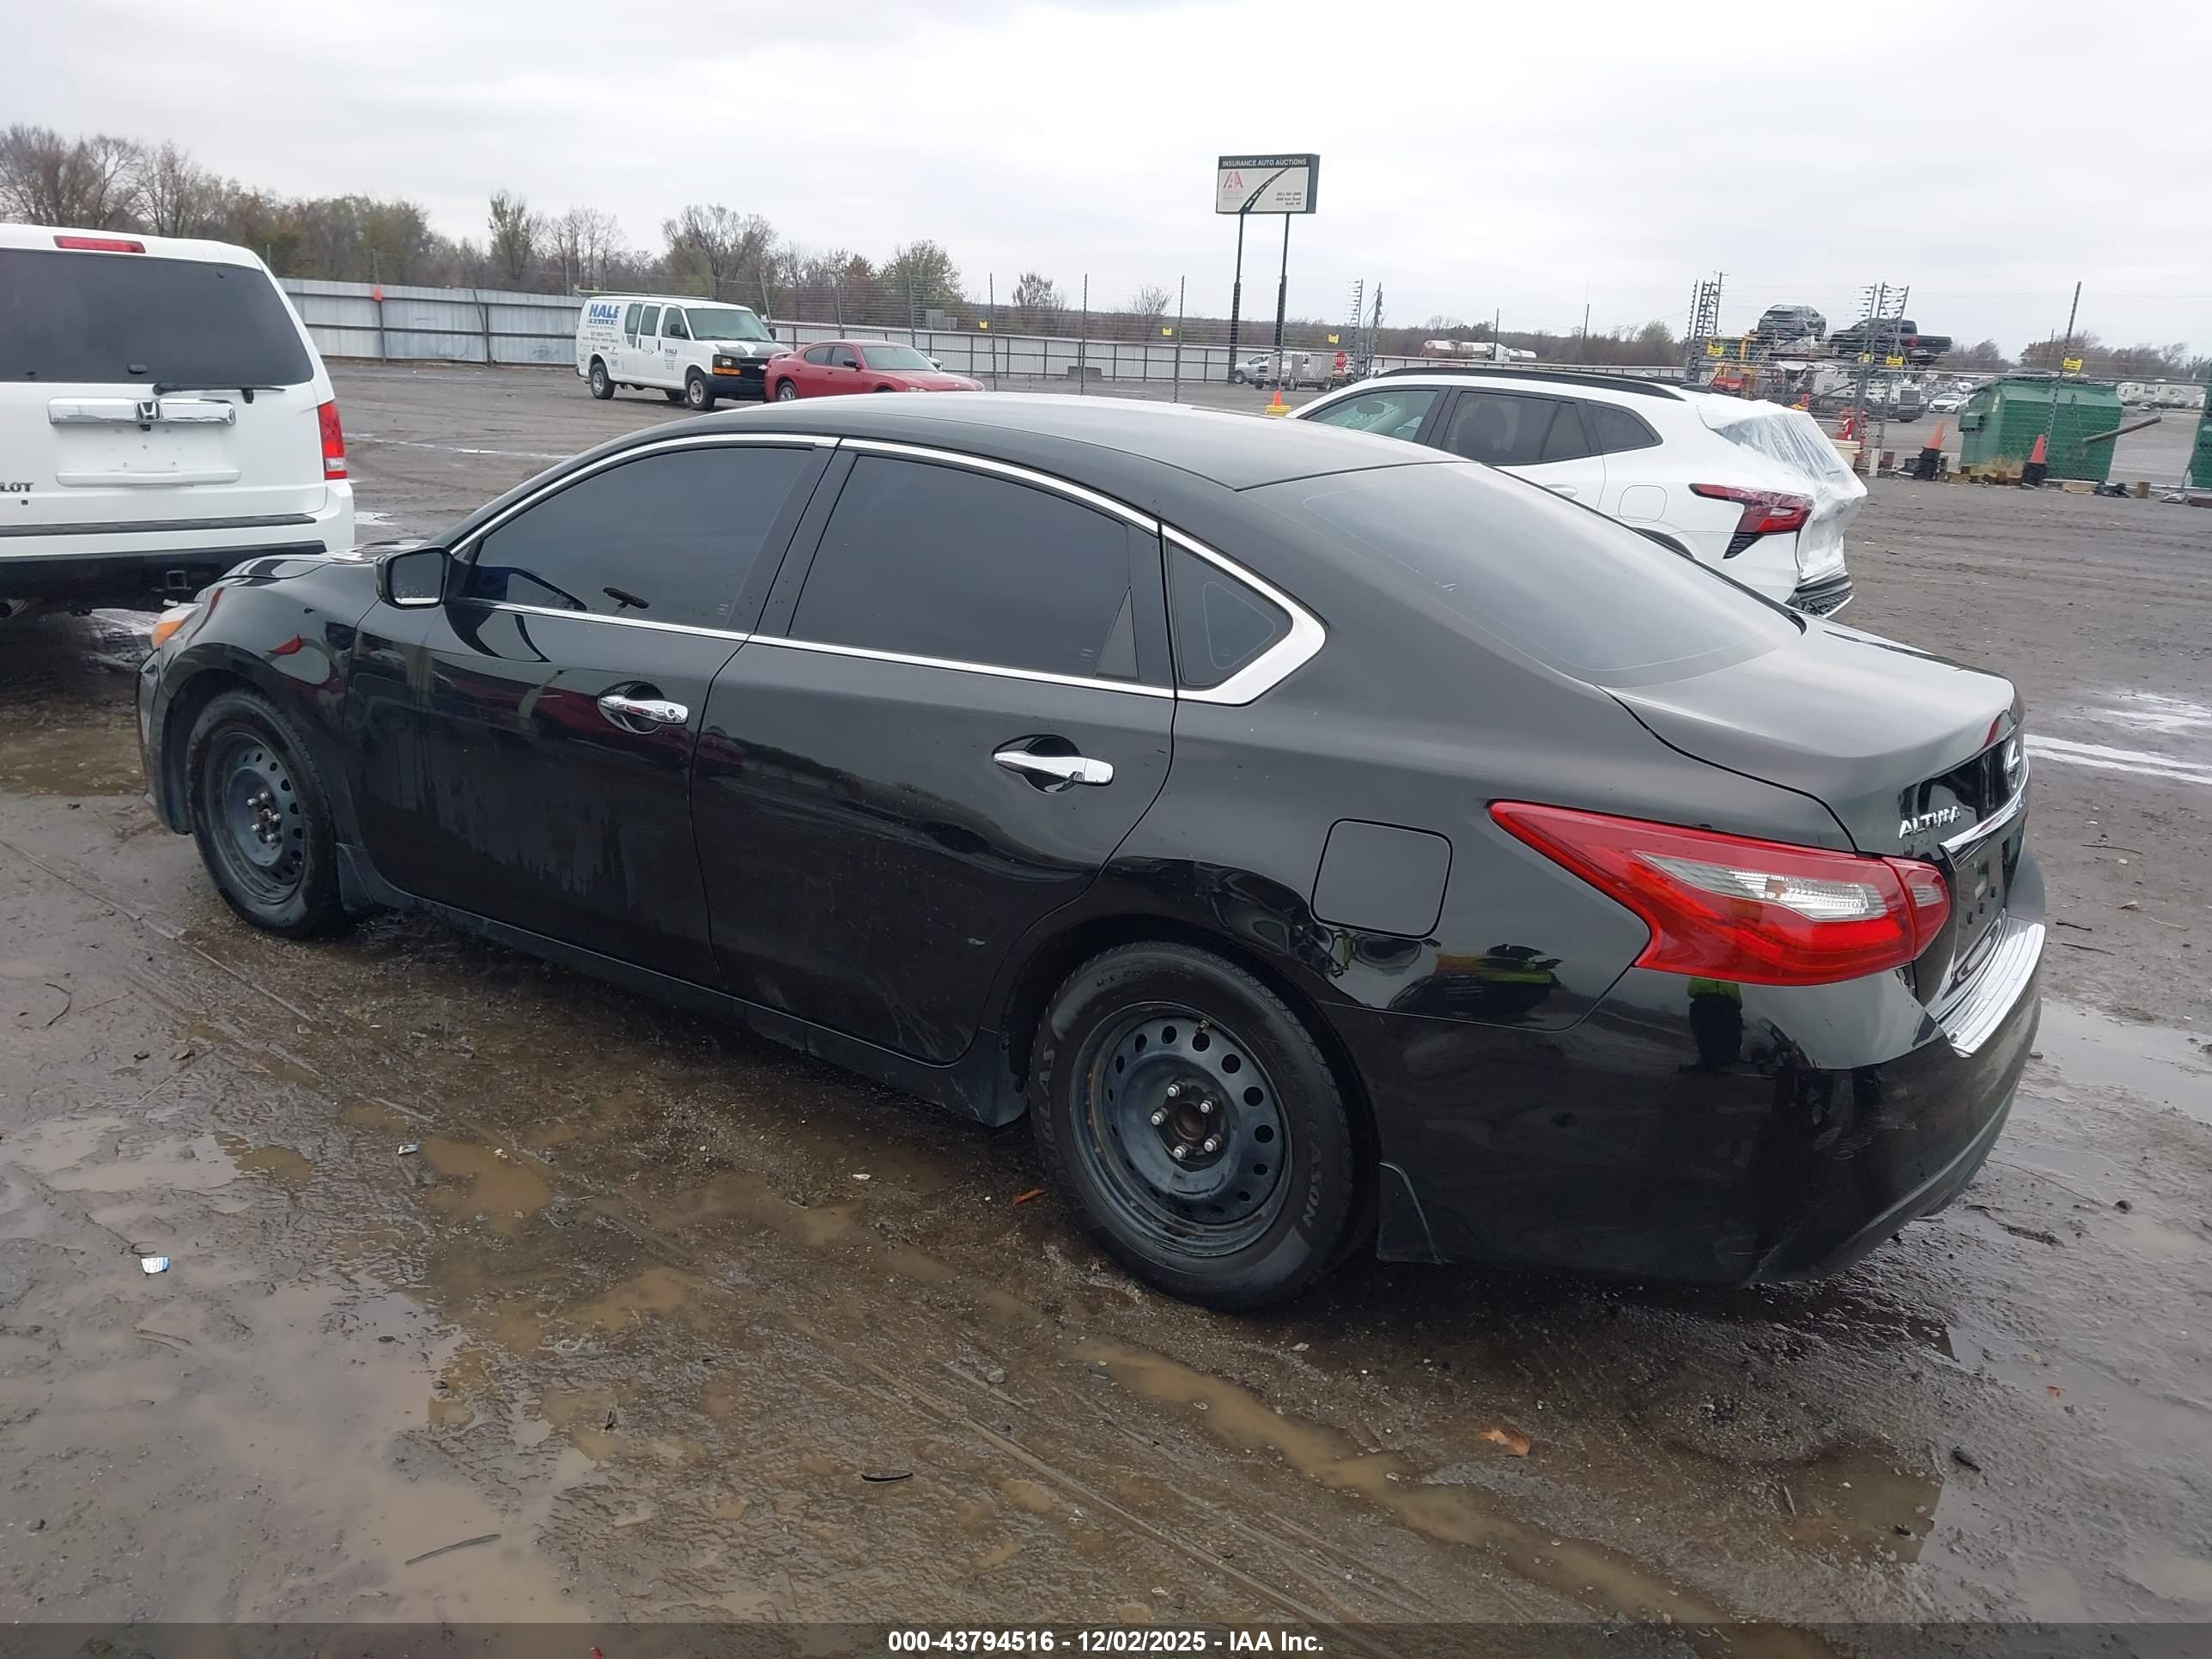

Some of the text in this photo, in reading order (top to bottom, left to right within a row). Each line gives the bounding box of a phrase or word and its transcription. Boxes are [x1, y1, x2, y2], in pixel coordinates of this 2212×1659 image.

[589, 304, 621, 318] HALE
[0, 482, 33, 493] LOT
[1899, 805, 1960, 839] ALTIMA
